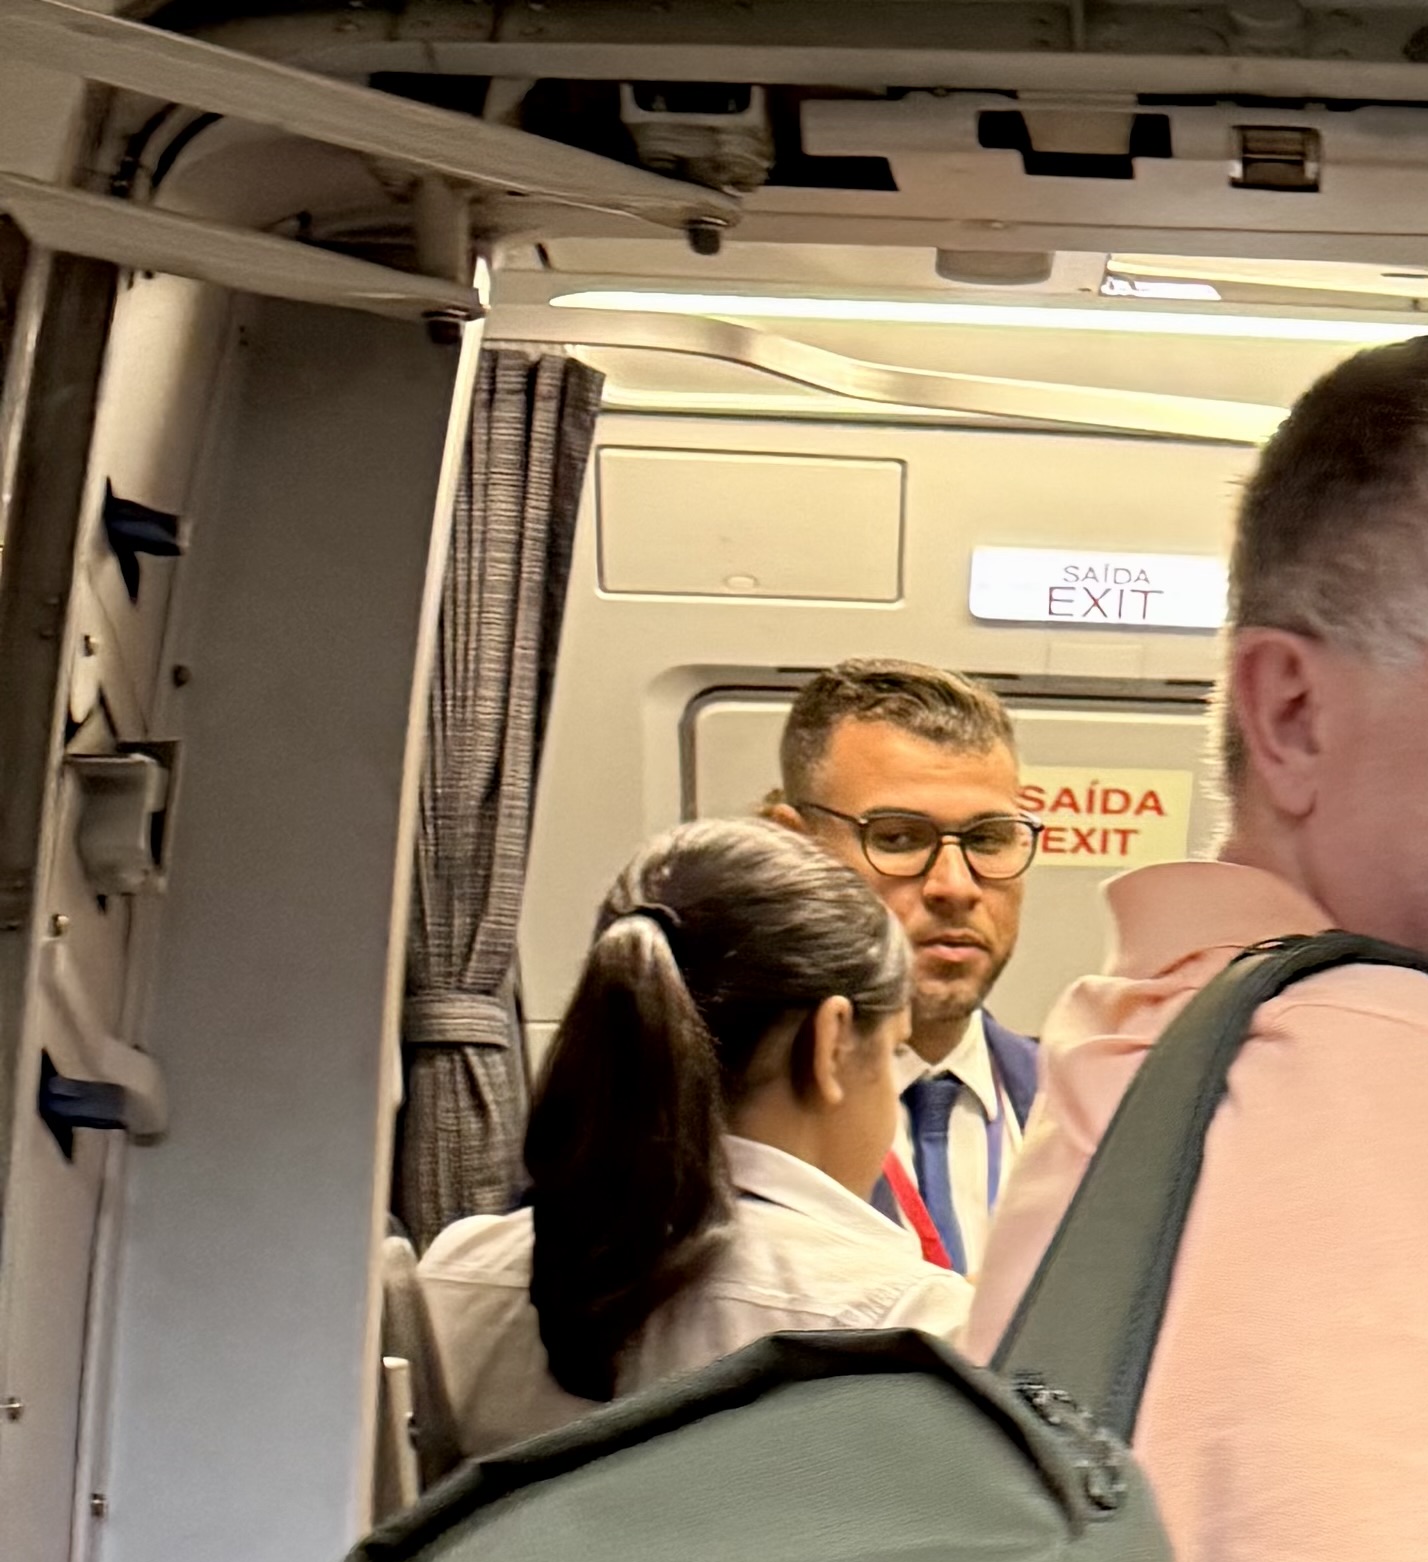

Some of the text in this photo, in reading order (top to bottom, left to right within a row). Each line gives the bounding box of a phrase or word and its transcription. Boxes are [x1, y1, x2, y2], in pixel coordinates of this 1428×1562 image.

[1063, 563, 1150, 584] SAÍDA
[1048, 586, 1164, 620] EXIT
[1018, 779, 1165, 816] SAÍDA
[1042, 826, 1139, 856] EXIT
